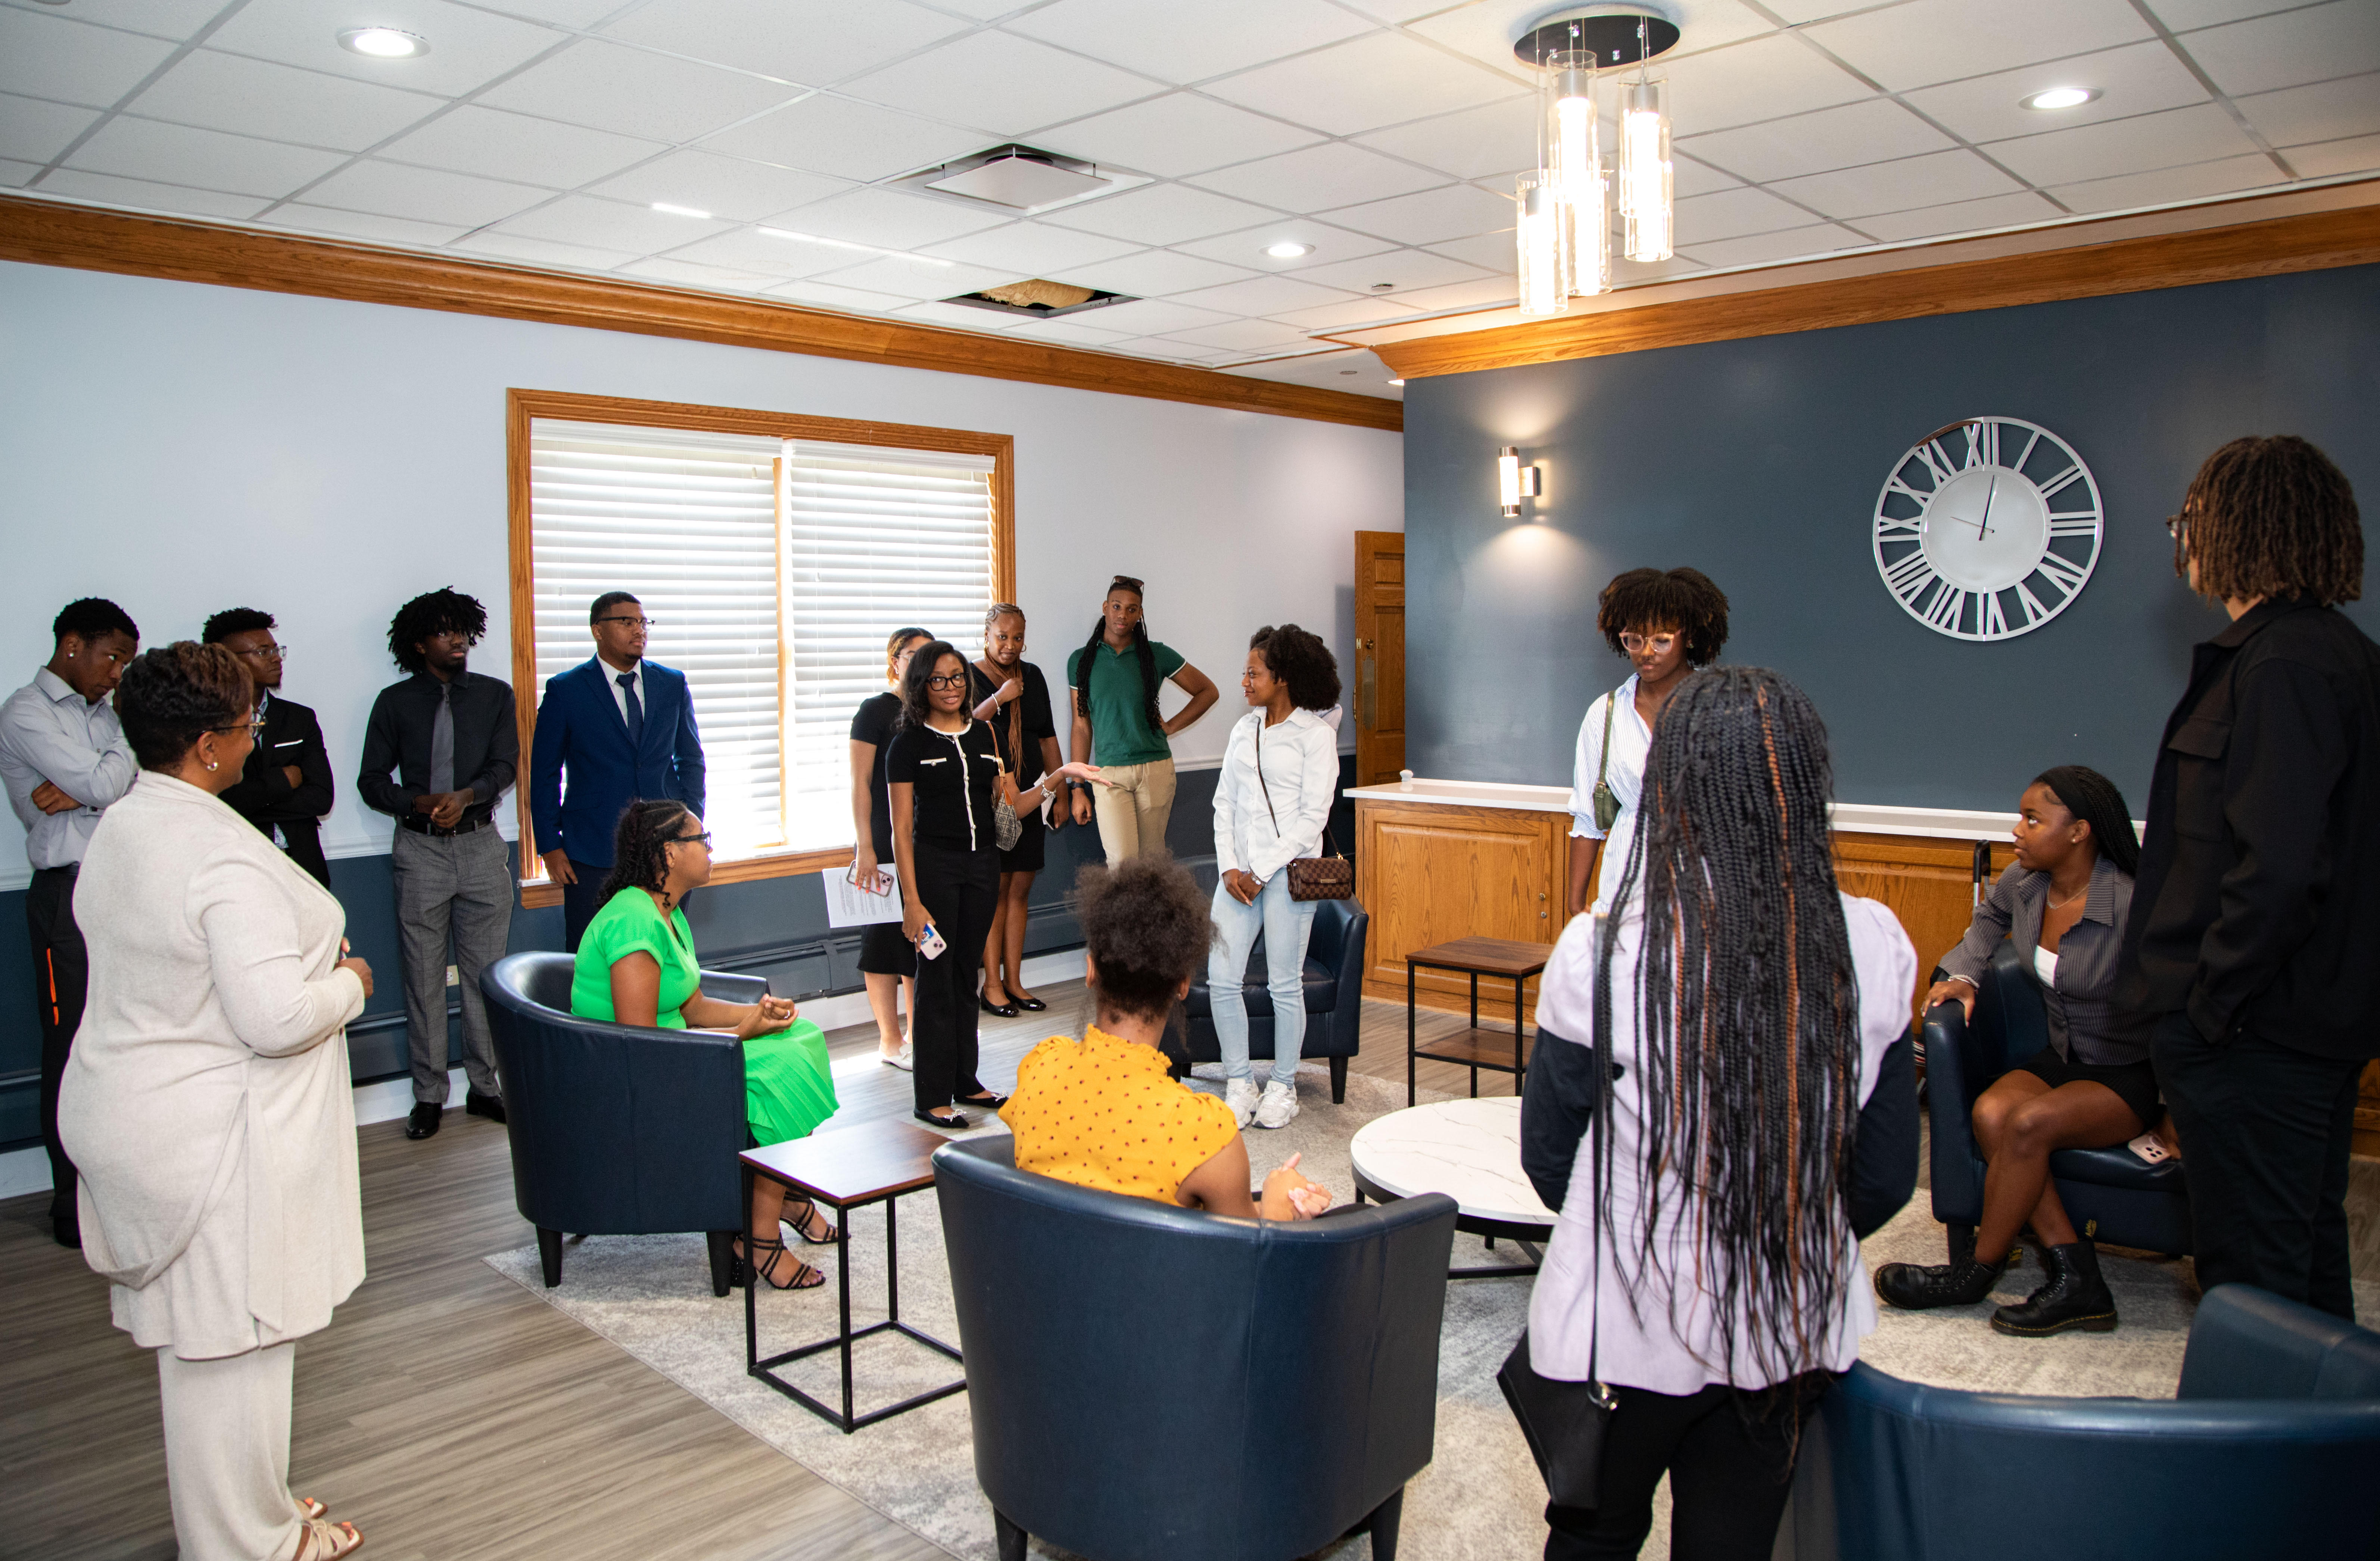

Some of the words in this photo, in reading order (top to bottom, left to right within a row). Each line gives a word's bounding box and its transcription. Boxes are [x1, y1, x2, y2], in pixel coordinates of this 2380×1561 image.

[1913, 439, 1957, 488] XI
[1963, 423, 1999, 469] XII
[2013, 431, 2041, 472] I
[1889, 476, 1933, 508] X
[2037, 464, 2084, 499] II
[1879, 515, 1922, 542] IX
[2050, 511, 2097, 537] III
[1885, 548, 1937, 605] VIII
[2036, 550, 2086, 597] IV
[1923, 581, 1966, 632] VII
[1977, 592, 2008, 635] VI
[2015, 581, 2049, 624] V
